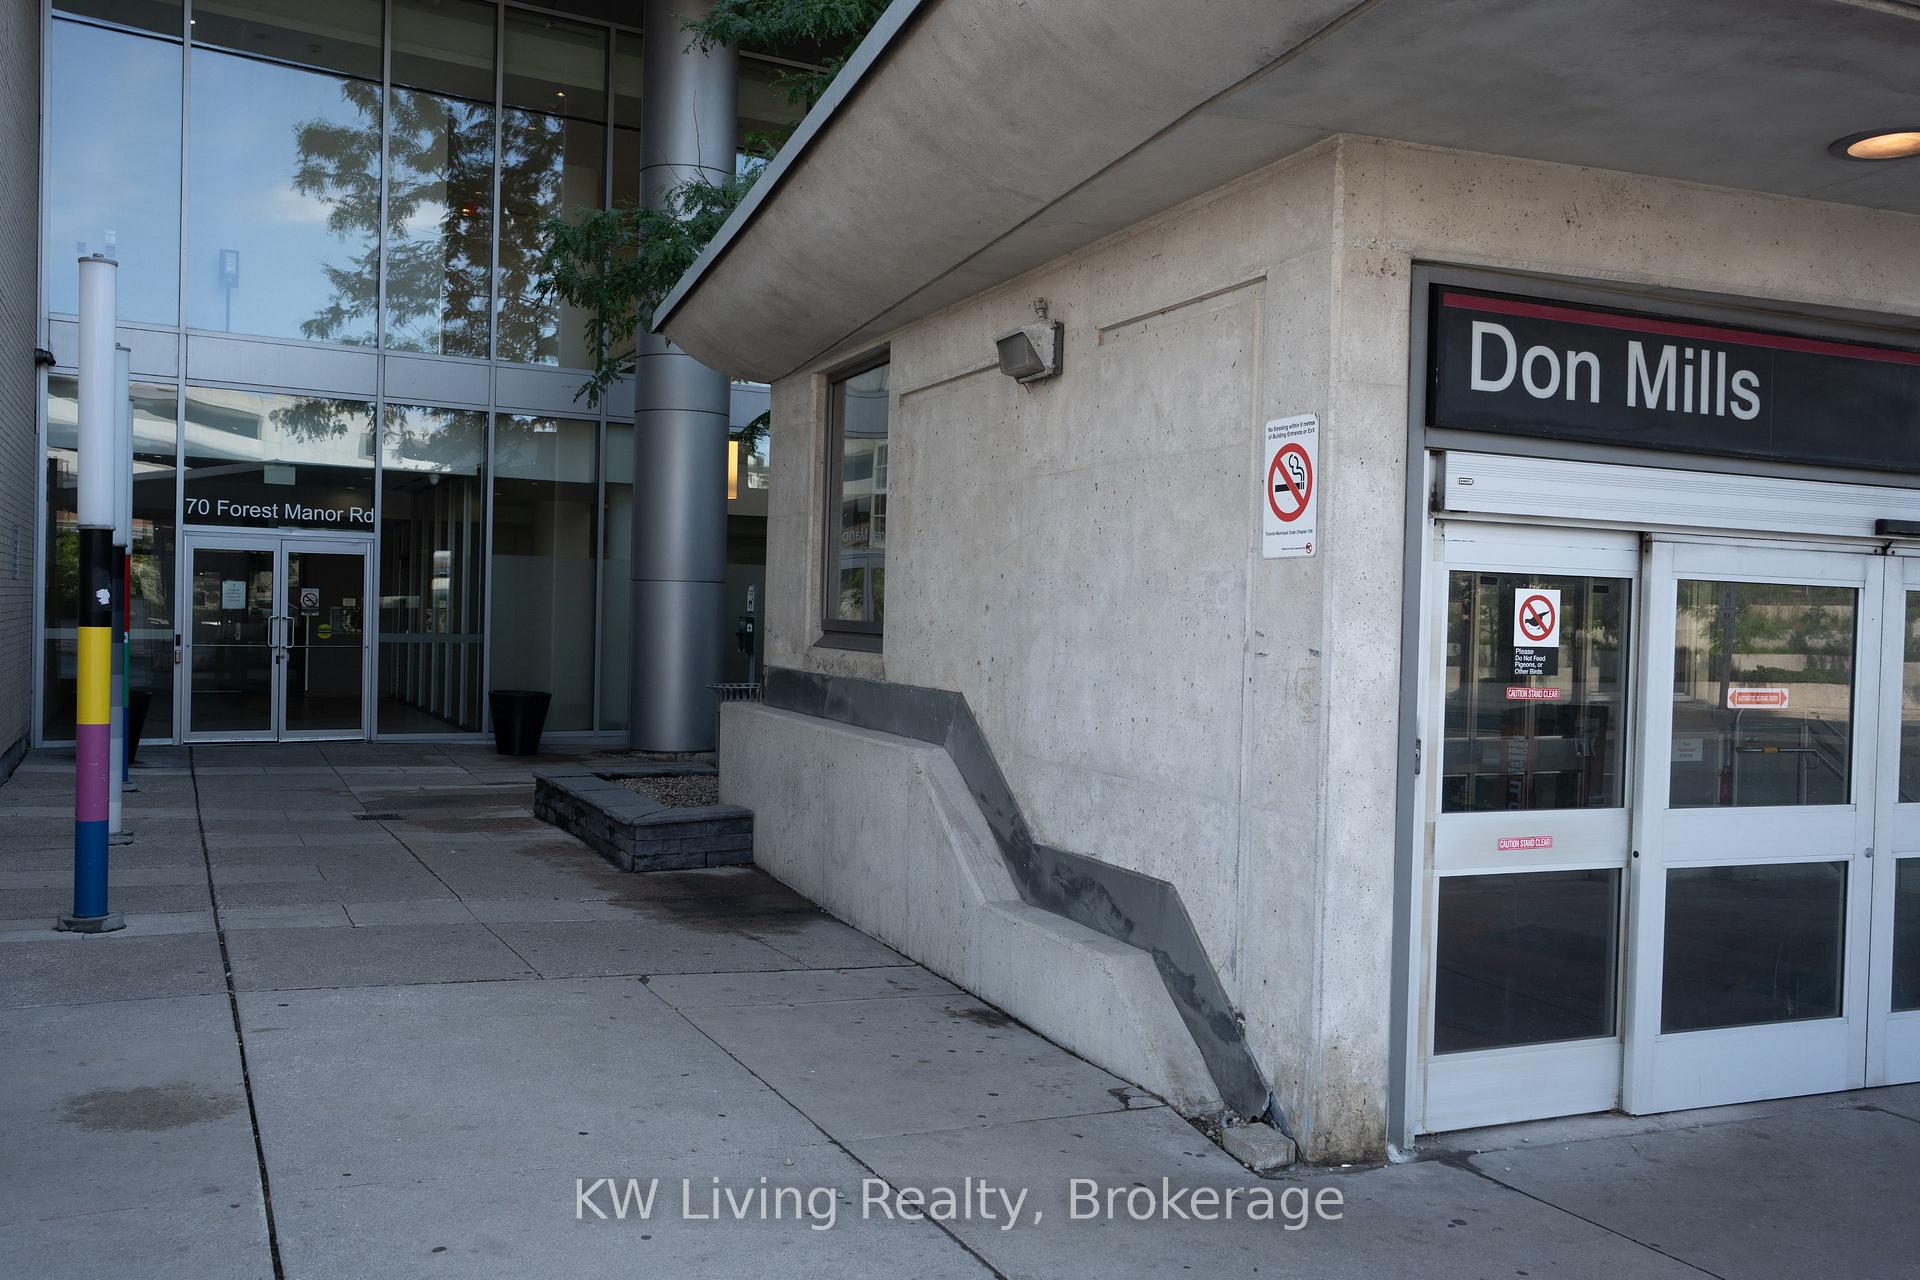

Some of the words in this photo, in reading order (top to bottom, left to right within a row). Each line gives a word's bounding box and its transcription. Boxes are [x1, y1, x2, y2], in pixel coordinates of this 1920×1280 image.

[1470, 320, 1600, 403] Don
[1627, 340, 1761, 420] Mills
[185, 498, 210, 515] 70
[217, 500, 278, 519] Forest
[285, 503, 344, 522] Manor
[350, 507, 374, 523] Rd
[1508, 689, 1527, 697] CAUTION
[1528, 690, 1542, 698] STAND
[1543, 690, 1558, 698] CLEAR
[1500, 840, 1519, 848] CAUTION
[1520, 839, 1534, 847] STAND
[1535, 838, 1550, 847] CLEAR
